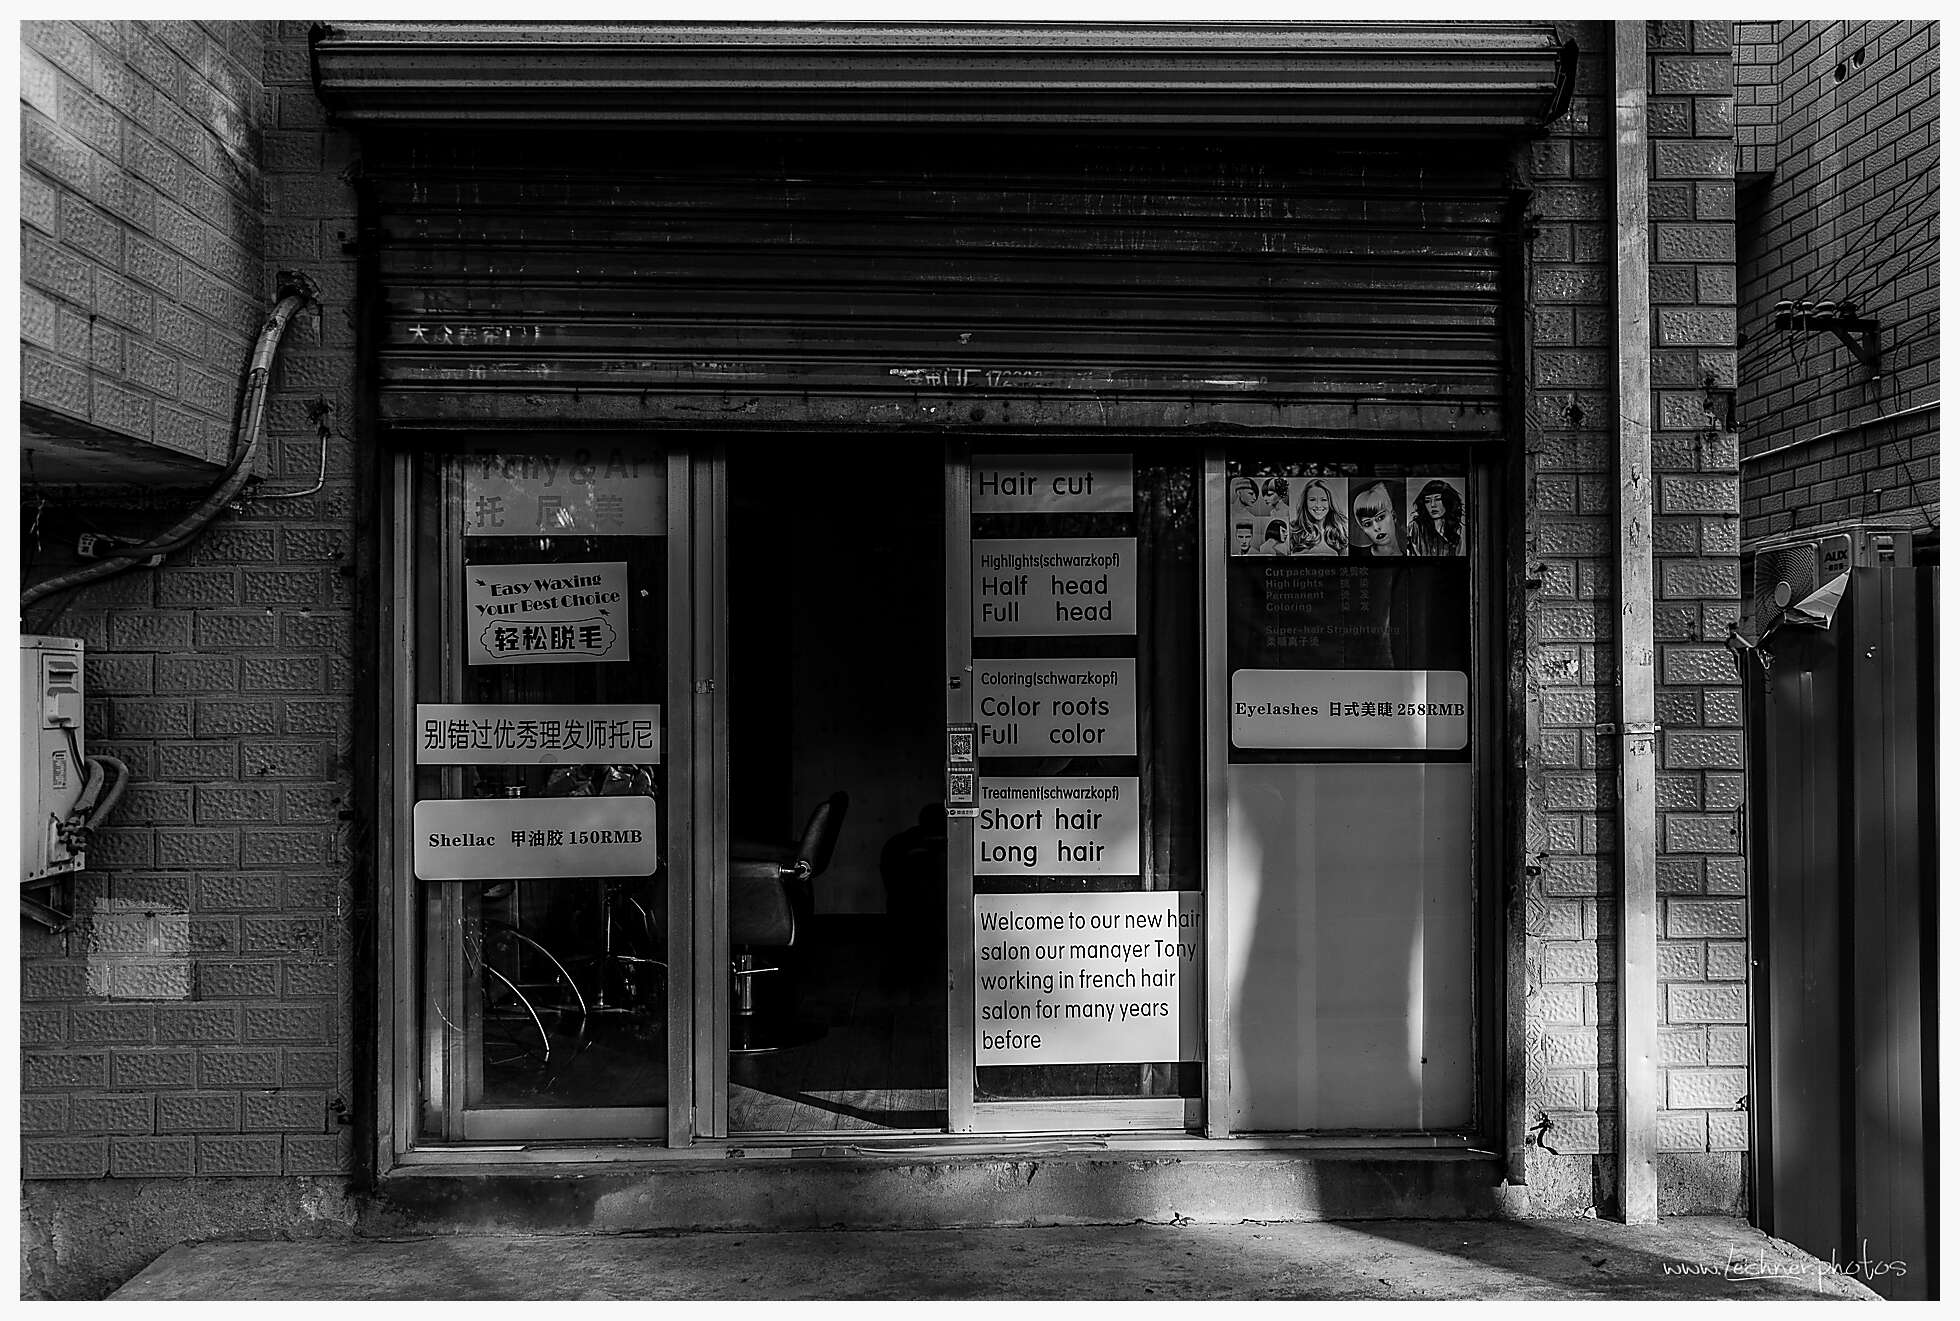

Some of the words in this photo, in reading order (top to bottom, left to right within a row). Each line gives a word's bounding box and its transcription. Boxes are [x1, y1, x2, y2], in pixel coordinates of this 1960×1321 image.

[979, 472, 1037, 496] Hair
[1053, 472, 1093, 495] cut
[1824, 550, 1848, 562] AUX
[491, 582, 531, 596] Easy
[534, 575, 601, 592] Waxing
[982, 575, 1027, 596] Half
[1051, 575, 1107, 595] head
[475, 604, 518, 616] Your
[522, 598, 558, 612] Best
[561, 591, 620, 608] Choice
[982, 601, 1019, 622] Full
[1057, 601, 1112, 621] head
[495, 626, 602, 650] 轻松脱毛
[981, 696, 1040, 716] Color
[1053, 697, 1109, 716] roots
[1235, 703, 1318, 717] Eyelashes
[1330, 702, 1392, 717] 日式美睫
[1398, 703, 1464, 716] 258RMB
[424, 719, 652, 750] 别错过优秀理发师托尼
[982, 724, 1018, 744] Full
[1050, 723, 1105, 743] color
[981, 808, 1042, 830] Short
[1056, 808, 1102, 829] hair
[429, 834, 496, 847] Shellac
[511, 830, 563, 847] 甲油胶
[569, 830, 642, 844] 150RMB
[981, 842, 1037, 867] Long
[1058, 840, 1104, 862] hair
[981, 911, 1064, 930] Welcome
[1069, 912, 1085, 929] to
[1091, 914, 1120, 929] our
[1125, 912, 1162, 928] new
[1167, 909, 1200, 928] hair
[981, 941, 1029, 961] salon
[1035, 945, 1065, 959] our
[1155, 940, 1196, 961] Tony
[981, 971, 1053, 993] working
[1059, 971, 1073, 989] in
[1080, 969, 1136, 989] french
[1141, 969, 1176, 987] hair
[982, 1000, 1031, 1020] salon
[1036, 1000, 1060, 1019] for
[1065, 1003, 1114, 1022] many
[1119, 1002, 1169, 1021] years
[983, 1030, 1041, 1049] before
